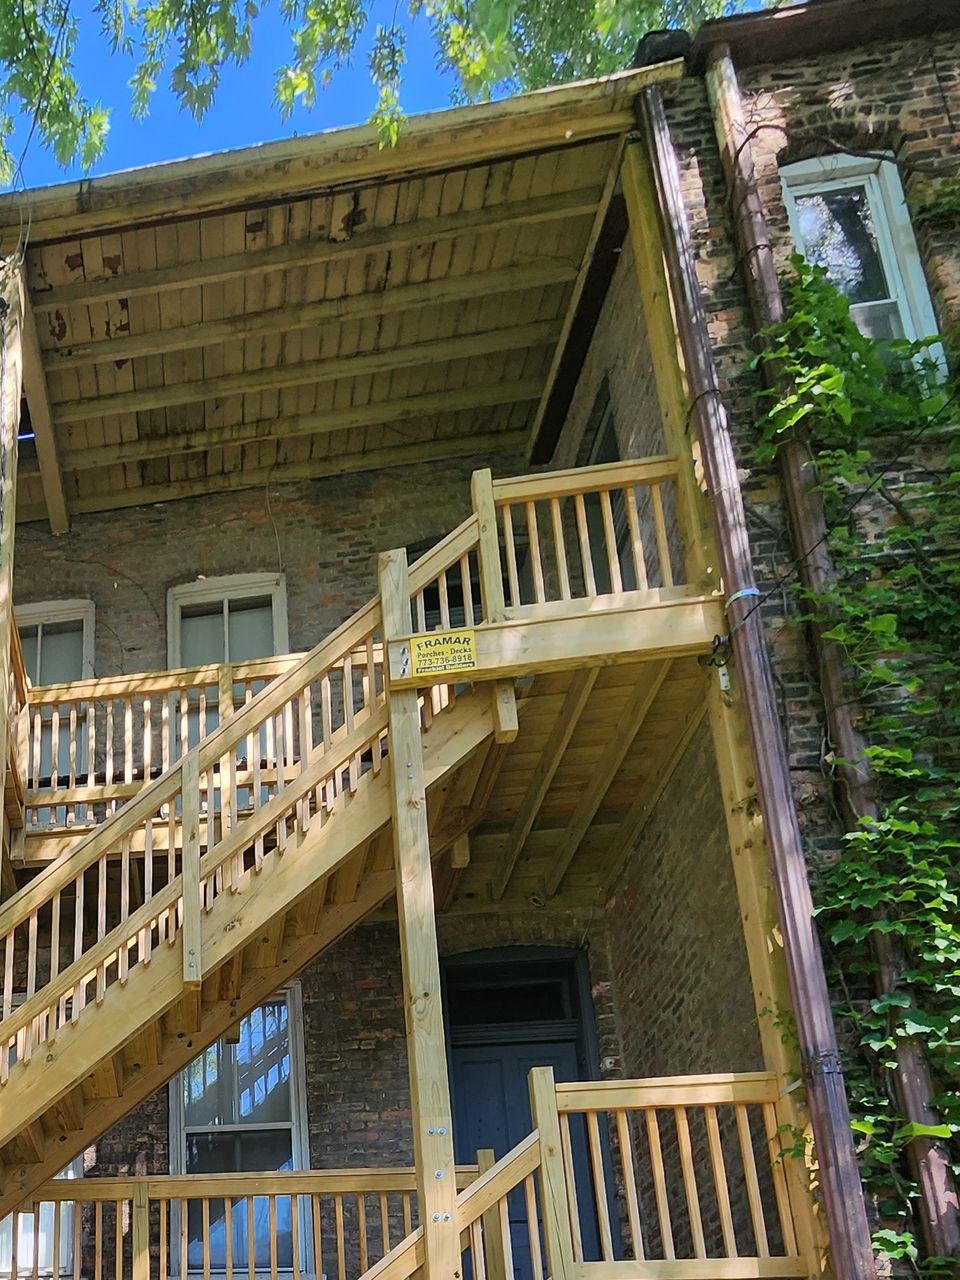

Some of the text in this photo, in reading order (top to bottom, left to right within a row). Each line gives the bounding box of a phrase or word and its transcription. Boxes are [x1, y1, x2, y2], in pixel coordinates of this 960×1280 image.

[416, 636, 471, 651] FRAMAR
[417, 650, 444, 658] Porches
[450, 647, 472, 655] Decks
[417, 654, 473, 666] 773-736-8918
